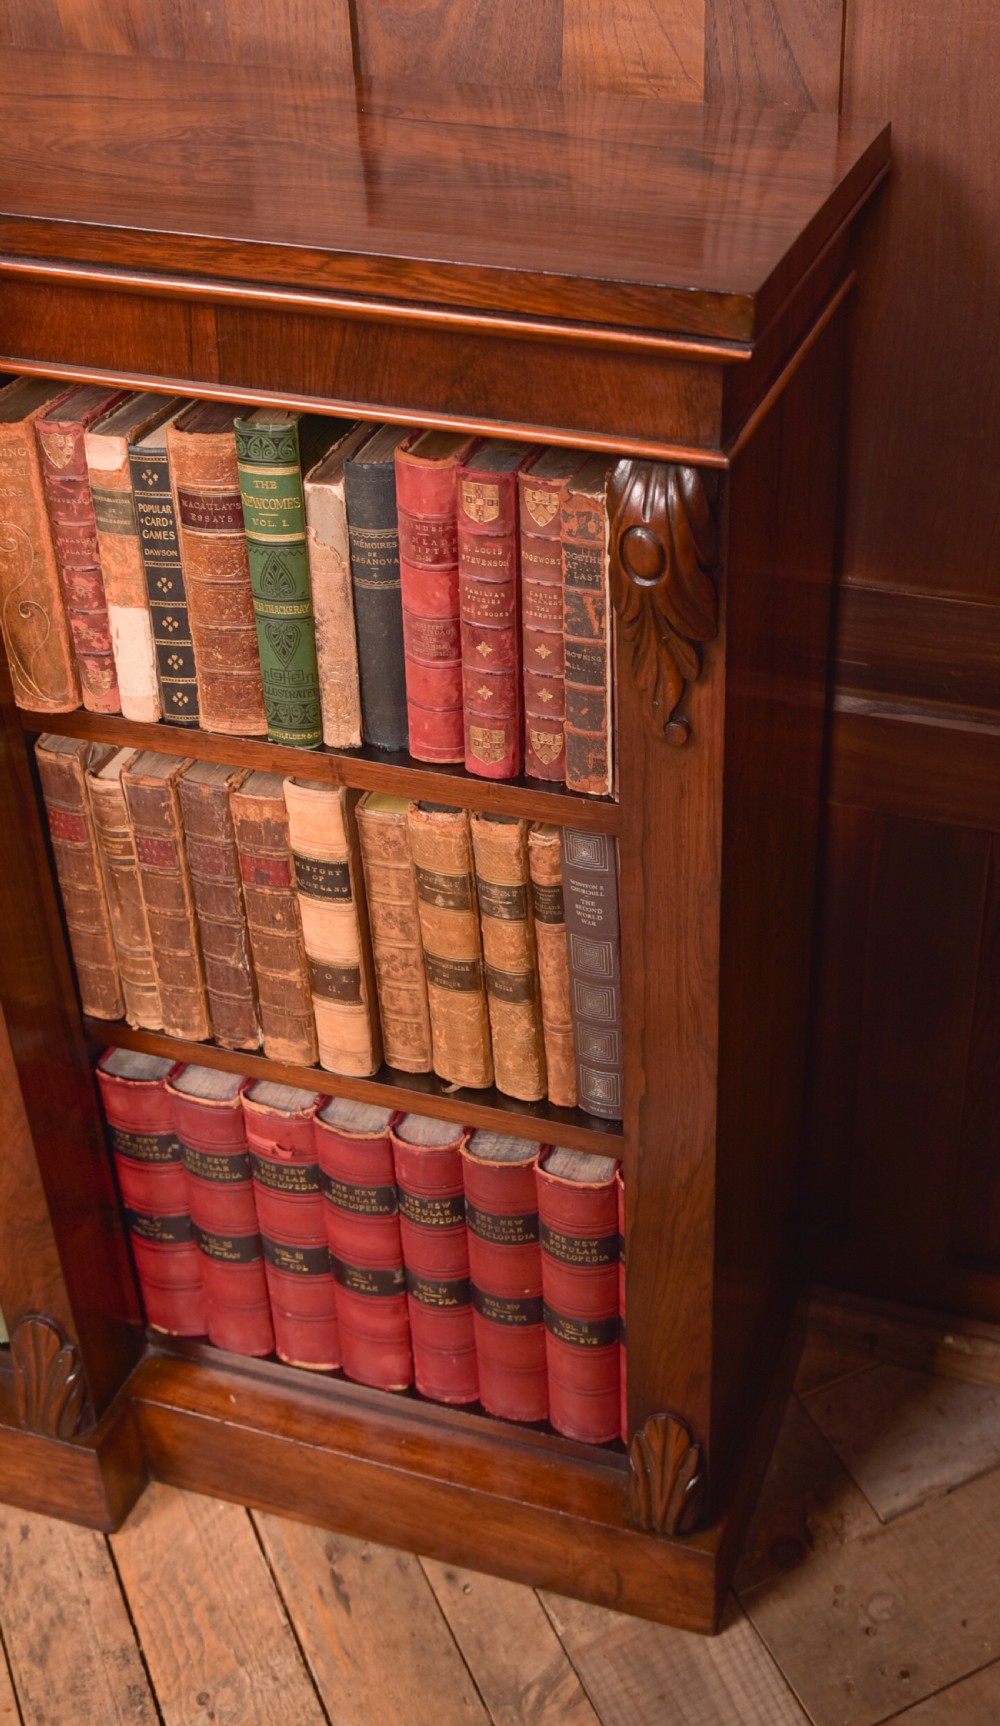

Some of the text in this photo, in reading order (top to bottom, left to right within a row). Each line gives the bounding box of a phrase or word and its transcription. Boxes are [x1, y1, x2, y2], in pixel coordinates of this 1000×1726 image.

[253, 480, 277, 490] THE
[181, 500, 242, 511] MACAULAY'S
[241, 492, 301, 510] NEWCOMES
[138, 503, 172, 514] POPULAR
[144, 517, 168, 527] CARD
[191, 513, 233, 523] ESSAYS
[252, 517, 277, 528] VOL.
[143, 530, 175, 540] GAMES
[353, 539, 397, 549] MÉMOIRES
[145, 549, 178, 557] DAWSON
[475, 546, 502, 555] LOUIS
[351, 555, 399, 566] CASANOVA
[462, 554, 509, 567] STEVENSON
[521, 550, 562, 565] EDGEWORT
[565, 551, 602, 564] OGETHE
[465, 587, 505, 598] FAMILIAR
[296, 861, 342, 876] HISTORY
[312, 874, 324, 882] OF
[570, 879, 598, 890] WINSTON
[570, 886, 605, 897] CHURCHILL
[580, 898, 596, 906] THE
[575, 903, 603, 914] SECOND
[576, 910, 603, 920] WORLD
[580, 918, 597, 926] WAR
[186, 1154, 230, 1172] POPULAR
[206, 1156, 229, 1165] NEW
[260, 1160, 276, 1172] THE
[254, 1171, 319, 1190] ENCYCLOPEDIA
[261, 1168, 306, 1182] POPULAR
[330, 1181, 347, 1192] THE
[324, 1191, 390, 1212] ENCYCLOPEDIA
[332, 1188, 377, 1204] POPULAR
[404, 1195, 420, 1207] THE
[399, 1203, 463, 1224] ENCYCLOPEDIA
[405, 1201, 450, 1217] POPULAR
[475, 1211, 492, 1223] THE
[468, 1219, 535, 1242] ENCYCLOPEDIA
[476, 1218, 523, 1233] POPULAR
[549, 1231, 567, 1244] THE
[542, 1241, 609, 1262] ENCYCLOPEDIA
[550, 1239, 598, 1255] POPULAR
